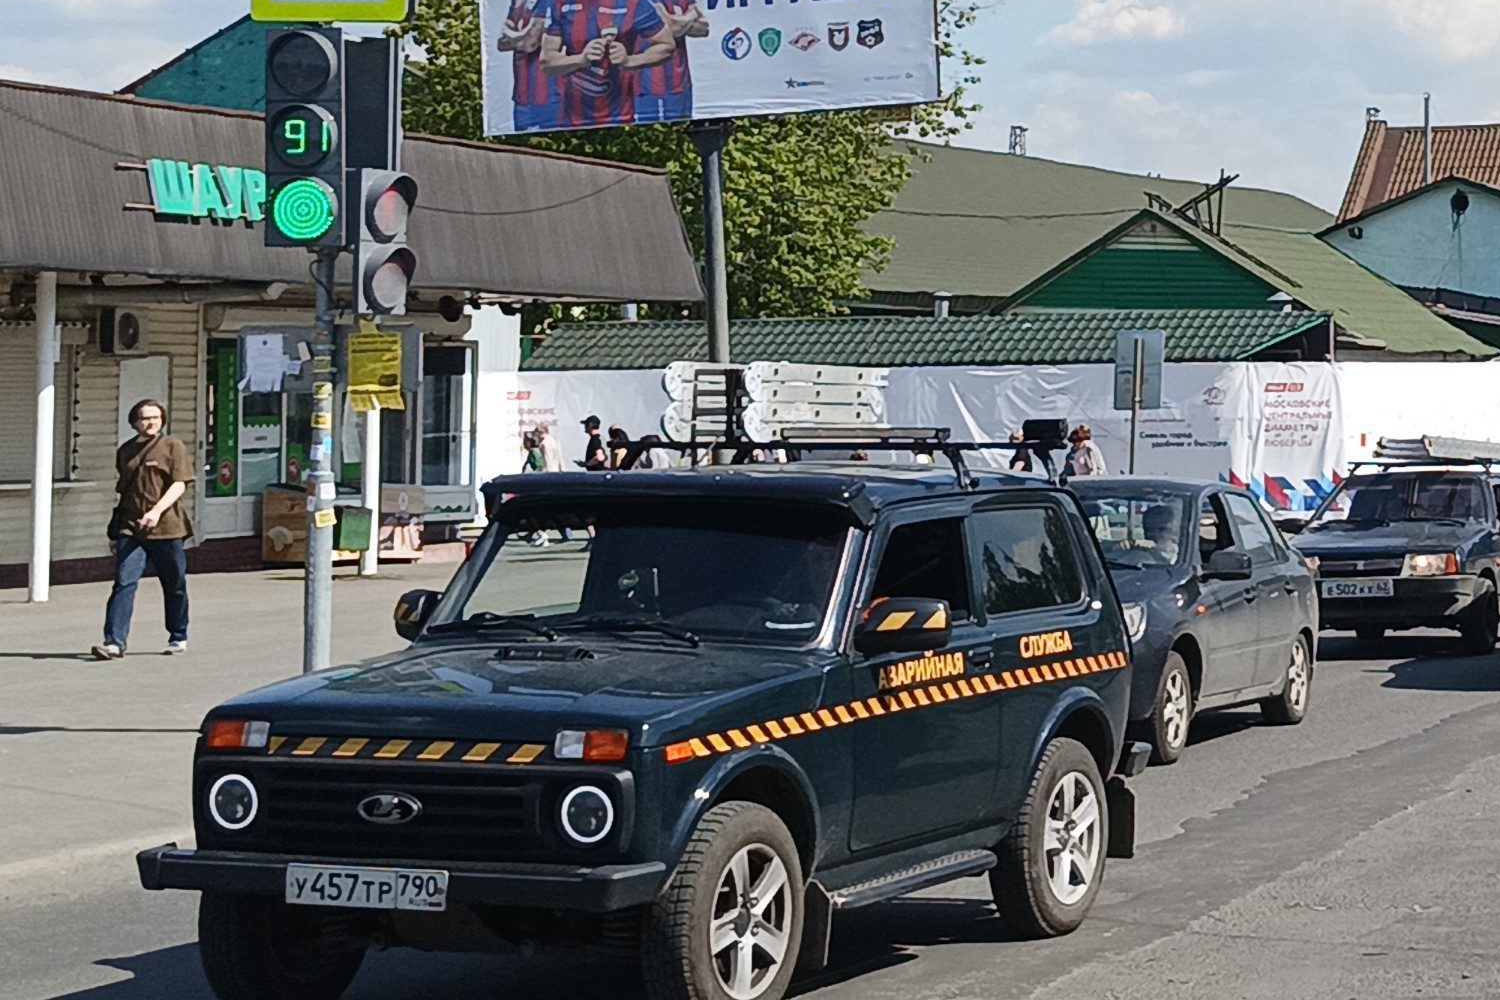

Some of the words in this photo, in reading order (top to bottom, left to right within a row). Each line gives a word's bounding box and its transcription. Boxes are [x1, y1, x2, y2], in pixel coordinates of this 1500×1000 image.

[284, 119, 328, 154] 91
[147, 158, 266, 221] ШАУР
[878, 650, 964, 689] АВАРИЙНАЯ
[1019, 630, 1073, 658] СЛУЖБА
